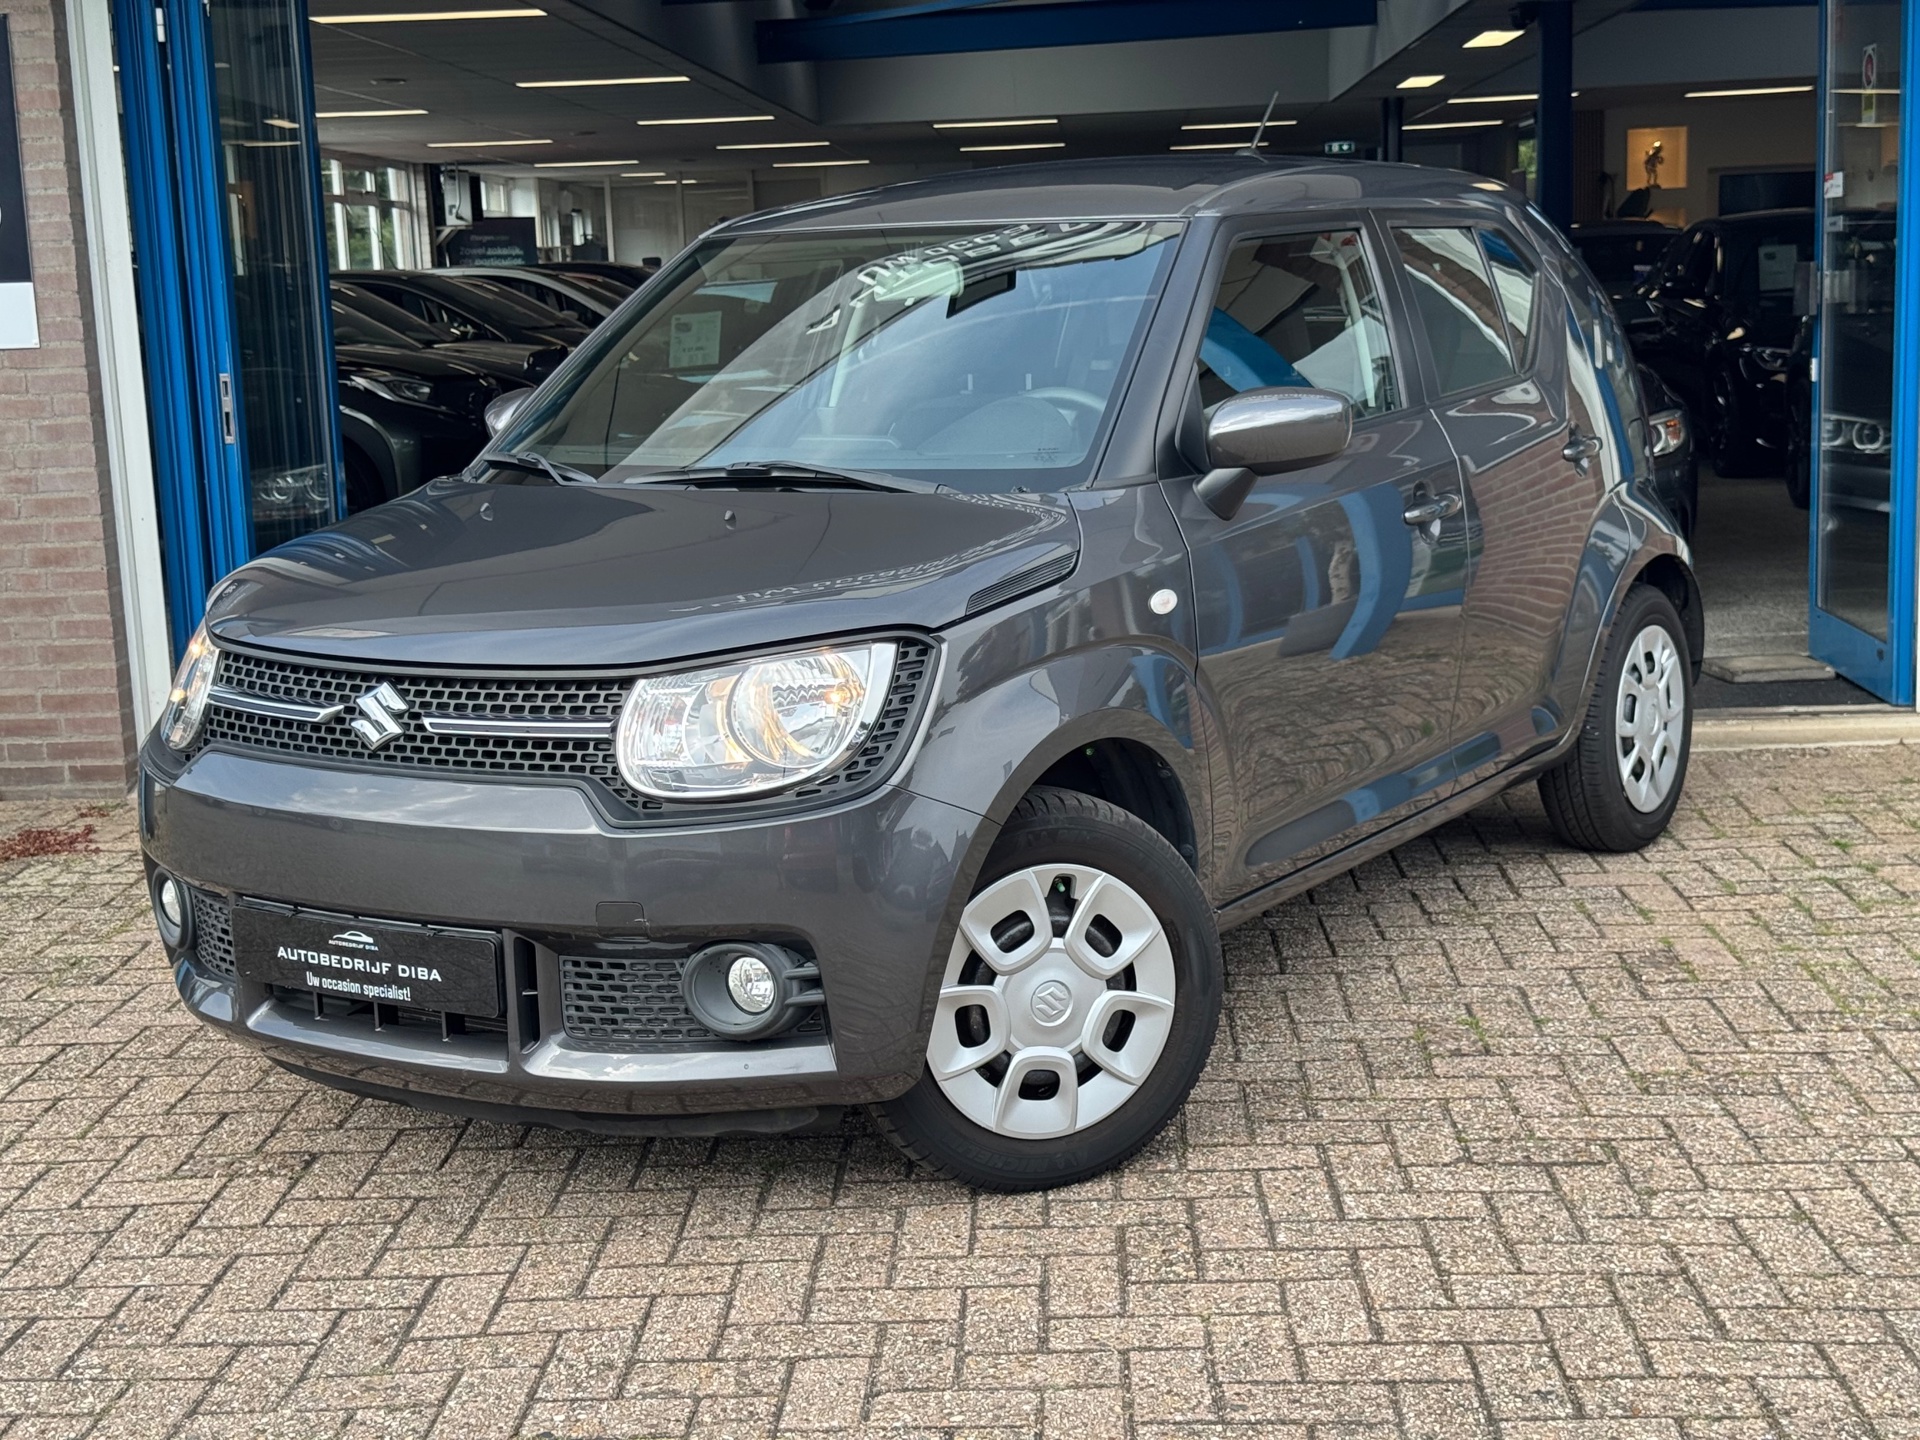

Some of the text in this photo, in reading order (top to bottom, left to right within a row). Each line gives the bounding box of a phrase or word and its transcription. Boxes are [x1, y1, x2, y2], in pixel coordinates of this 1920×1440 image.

[328, 939, 364, 949] AUTOBEDRIJF
[276, 946, 443, 982] AUTOBEDRIJF DIBA
[306, 971, 411, 1002] Uw occasion specialist!
